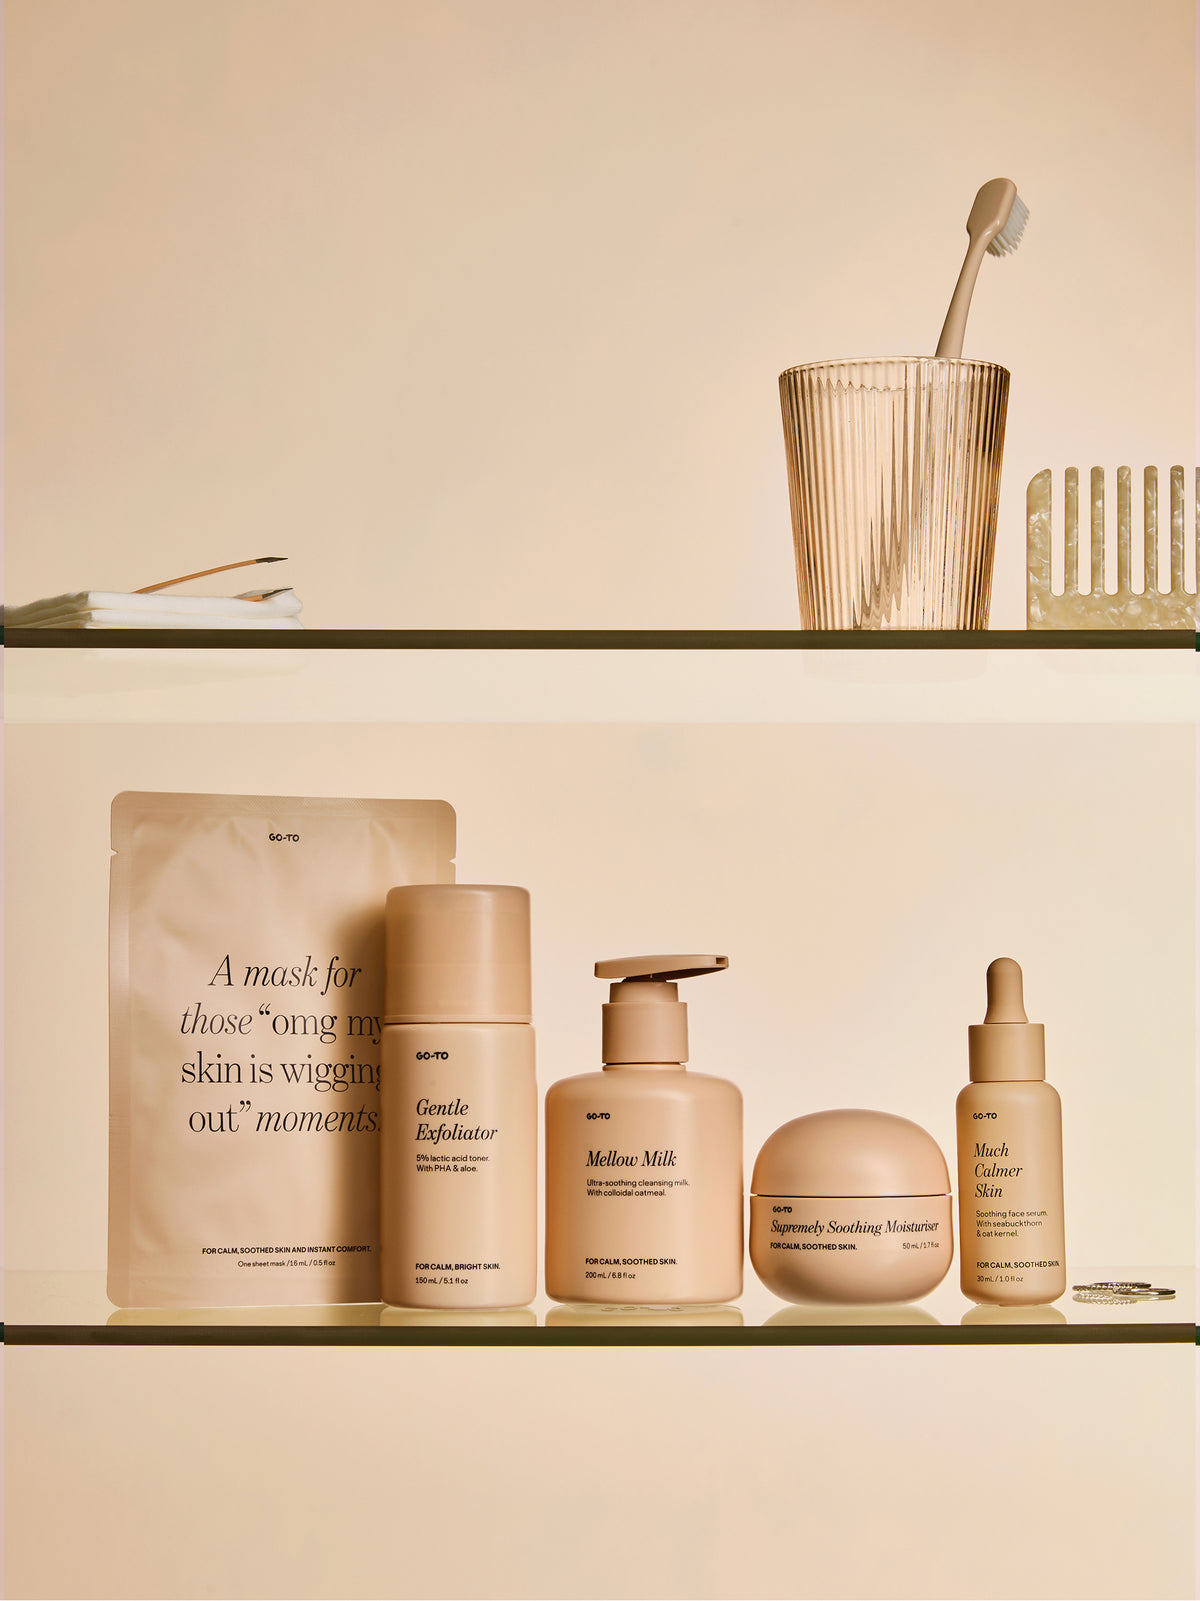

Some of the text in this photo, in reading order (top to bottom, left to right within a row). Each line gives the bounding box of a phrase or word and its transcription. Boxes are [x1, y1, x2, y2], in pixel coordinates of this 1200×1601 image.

[268, 832, 300, 842] GO-TO
[208, 954, 362, 996] A mask for
[180, 1002, 253, 1035] those
[416, 1051, 449, 1060] GO-TO
[181, 1050, 243, 1084] skin
[249, 1054, 274, 1084] is
[416, 1098, 469, 1116] Gentle
[586, 1112, 611, 1120] GO-TO
[972, 1112, 998, 1120] GO-TO
[415, 1123, 498, 1145] Exfoliator
[973, 1142, 1009, 1158] Much
[416, 1154, 430, 1162] 5%
[430, 1154, 450, 1162] lactic
[451, 1154, 468, 1162] acid
[586, 1150, 677, 1167] Mellow Milk
[416, 1164, 478, 1172] With PHA & aloe.
[974, 1162, 1023, 1178] Calmer
[586, 1179, 637, 1188] Ultra-soothing
[637, 1179, 674, 1188] cleansing
[586, 1188, 603, 1197] With
[603, 1188, 634, 1197] colloidal
[974, 1182, 1003, 1198] Skin
[976, 1209, 1007, 1219] Soothing
[1008, 1209, 1025, 1218] face
[770, 1219, 940, 1237] Supremely Soothing Moisturiser
[976, 1220, 1043, 1228] With seabuckthorn
[976, 1229, 982, 1238] &
[202, 1247, 217, 1255] FOR
[217, 1247, 240, 1255] CALM,
[240, 1246, 274, 1254] SOOTHED
[274, 1246, 291, 1254] SKIN
[291, 1246, 306, 1254] AND
[770, 1242, 858, 1251] FOR CALM, SOOTHED SKIN.
[902, 1242, 911, 1250] 50
[237, 1260, 252, 1268] One
[585, 1257, 599, 1265] FOR
[599, 1258, 622, 1266] CALM,
[976, 1261, 990, 1269] FOR
[1013, 1261, 1048, 1269] SOOTHED
[430, 1263, 454, 1271] CALM,
[585, 1271, 597, 1279] 200
[597, 1271, 607, 1279] mL
[976, 1275, 985, 1283] 30
[443, 1277, 454, 1285] 5.1
